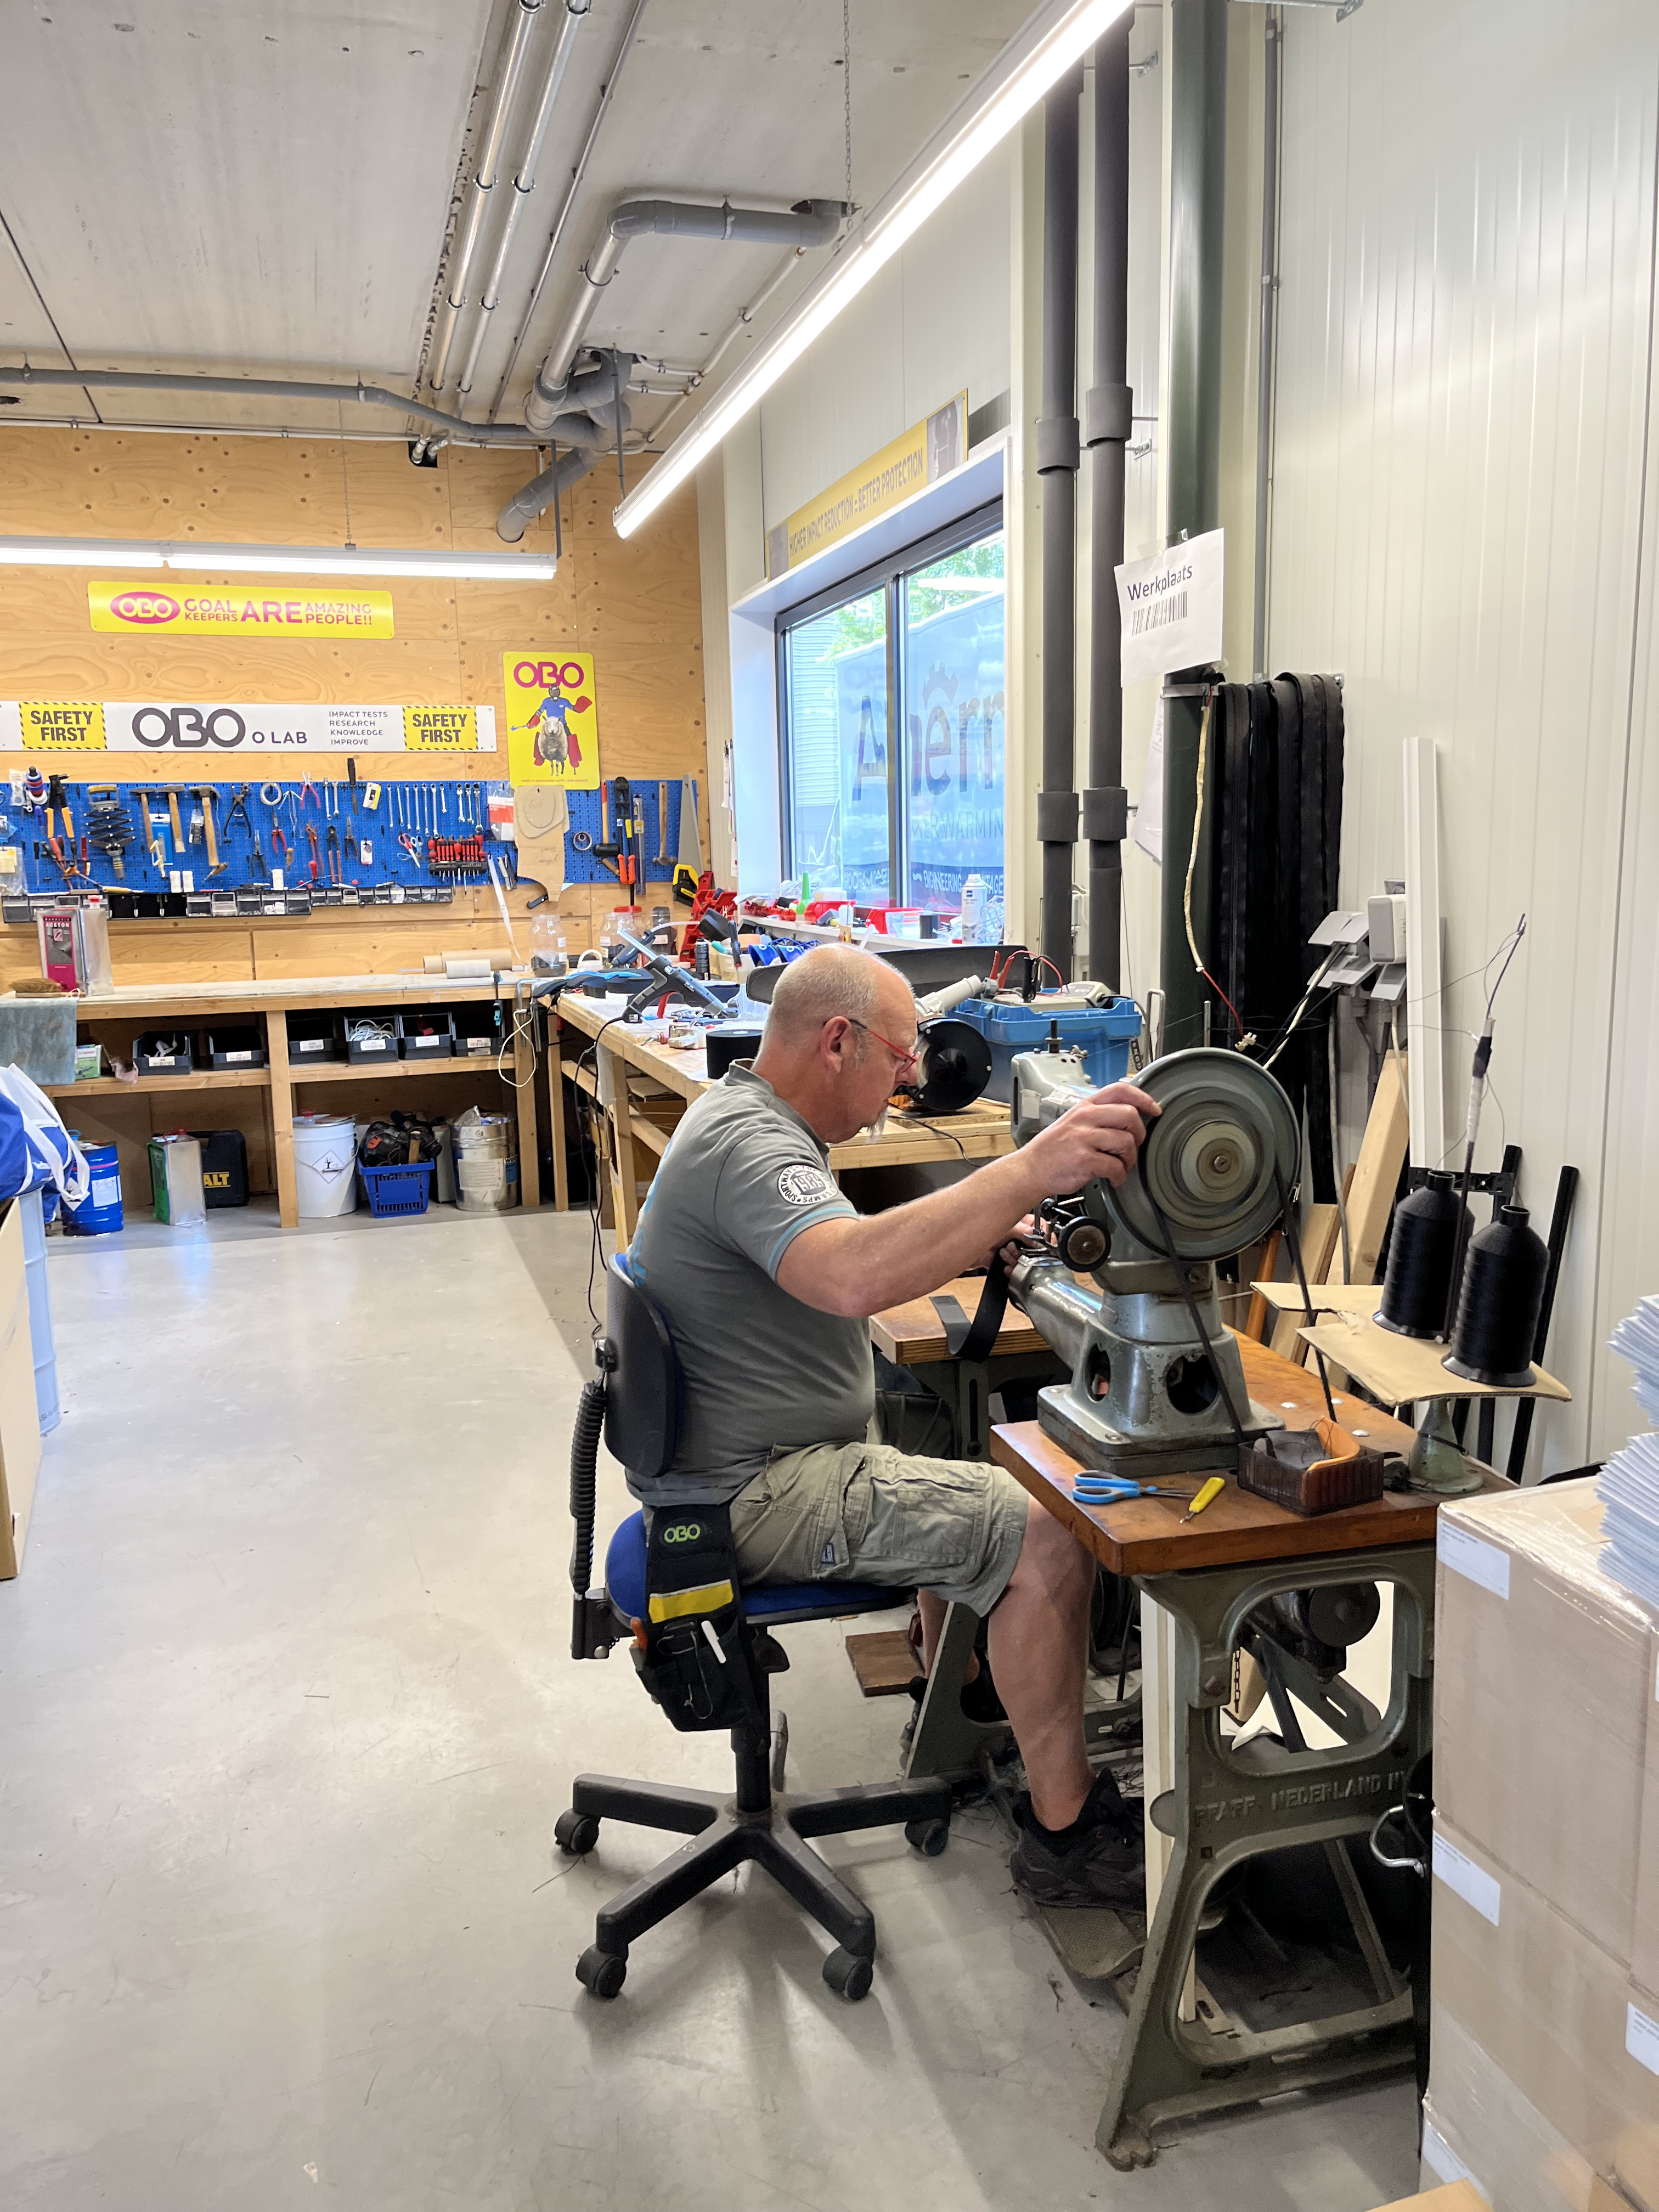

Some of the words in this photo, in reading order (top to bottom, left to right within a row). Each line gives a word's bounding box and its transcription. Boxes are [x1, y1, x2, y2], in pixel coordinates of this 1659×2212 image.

[789, 527, 806, 556] HIGHER
[808, 514, 824, 545] IMPACT
[825, 493, 854, 532] REDUCTION
[858, 475, 881, 512] BETTER
[882, 448, 923, 496] PROTECTION
[1127, 564, 1193, 601] Werkplaats
[117, 597, 172, 618] OBO
[184, 598, 237, 613] GOAL
[240, 601, 303, 624] ARE
[305, 602, 372, 614] AMAZING
[185, 612, 238, 622] KEEPERS
[306, 613, 373, 625] PEOPLE!!
[514, 661, 584, 689] OBO
[31, 710, 93, 726] SAFETY
[132, 707, 246, 748] OBO
[271, 731, 308, 744] LAB
[412, 714, 467, 727] SAFETY
[41, 727, 87, 742] FIRST
[421, 729, 461, 743] FIRST
[923, 870, 962, 893] ENGINEERING
[664, 1523, 701, 1543] OBO
[1271, 1773, 1381, 1810] NEDERLAND
